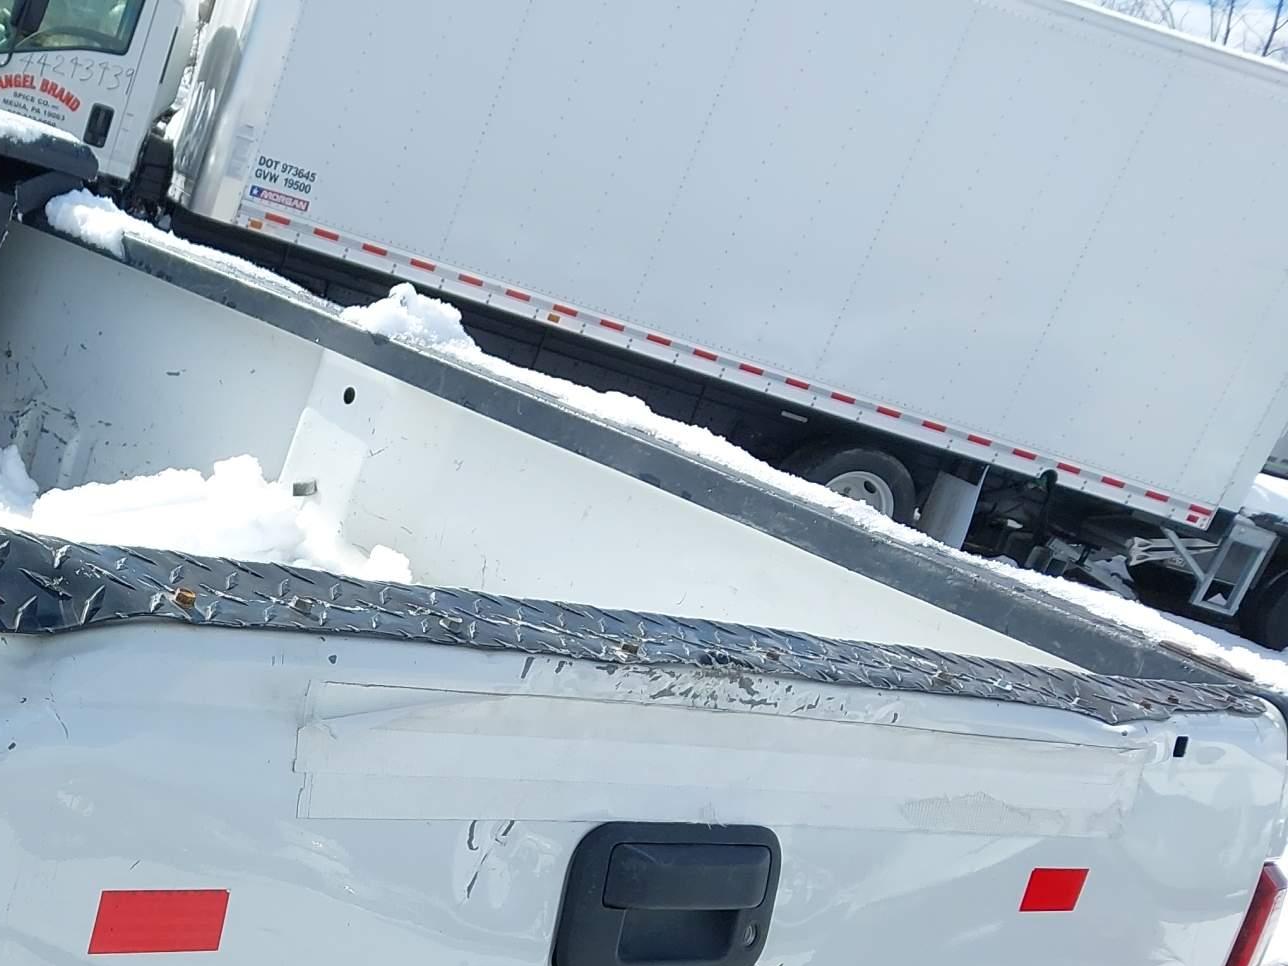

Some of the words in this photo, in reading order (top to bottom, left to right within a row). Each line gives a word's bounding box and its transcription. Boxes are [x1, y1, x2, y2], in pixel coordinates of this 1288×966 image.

[13, 91, 35, 103] SPICE
[39, 78, 82, 113] BRAND
[254, 168, 280, 184] GVW
[283, 177, 312, 195] 19500
[258, 155, 281, 172] DOT
[280, 162, 317, 183] 973645
[260, 189, 308, 212] MORGAN
